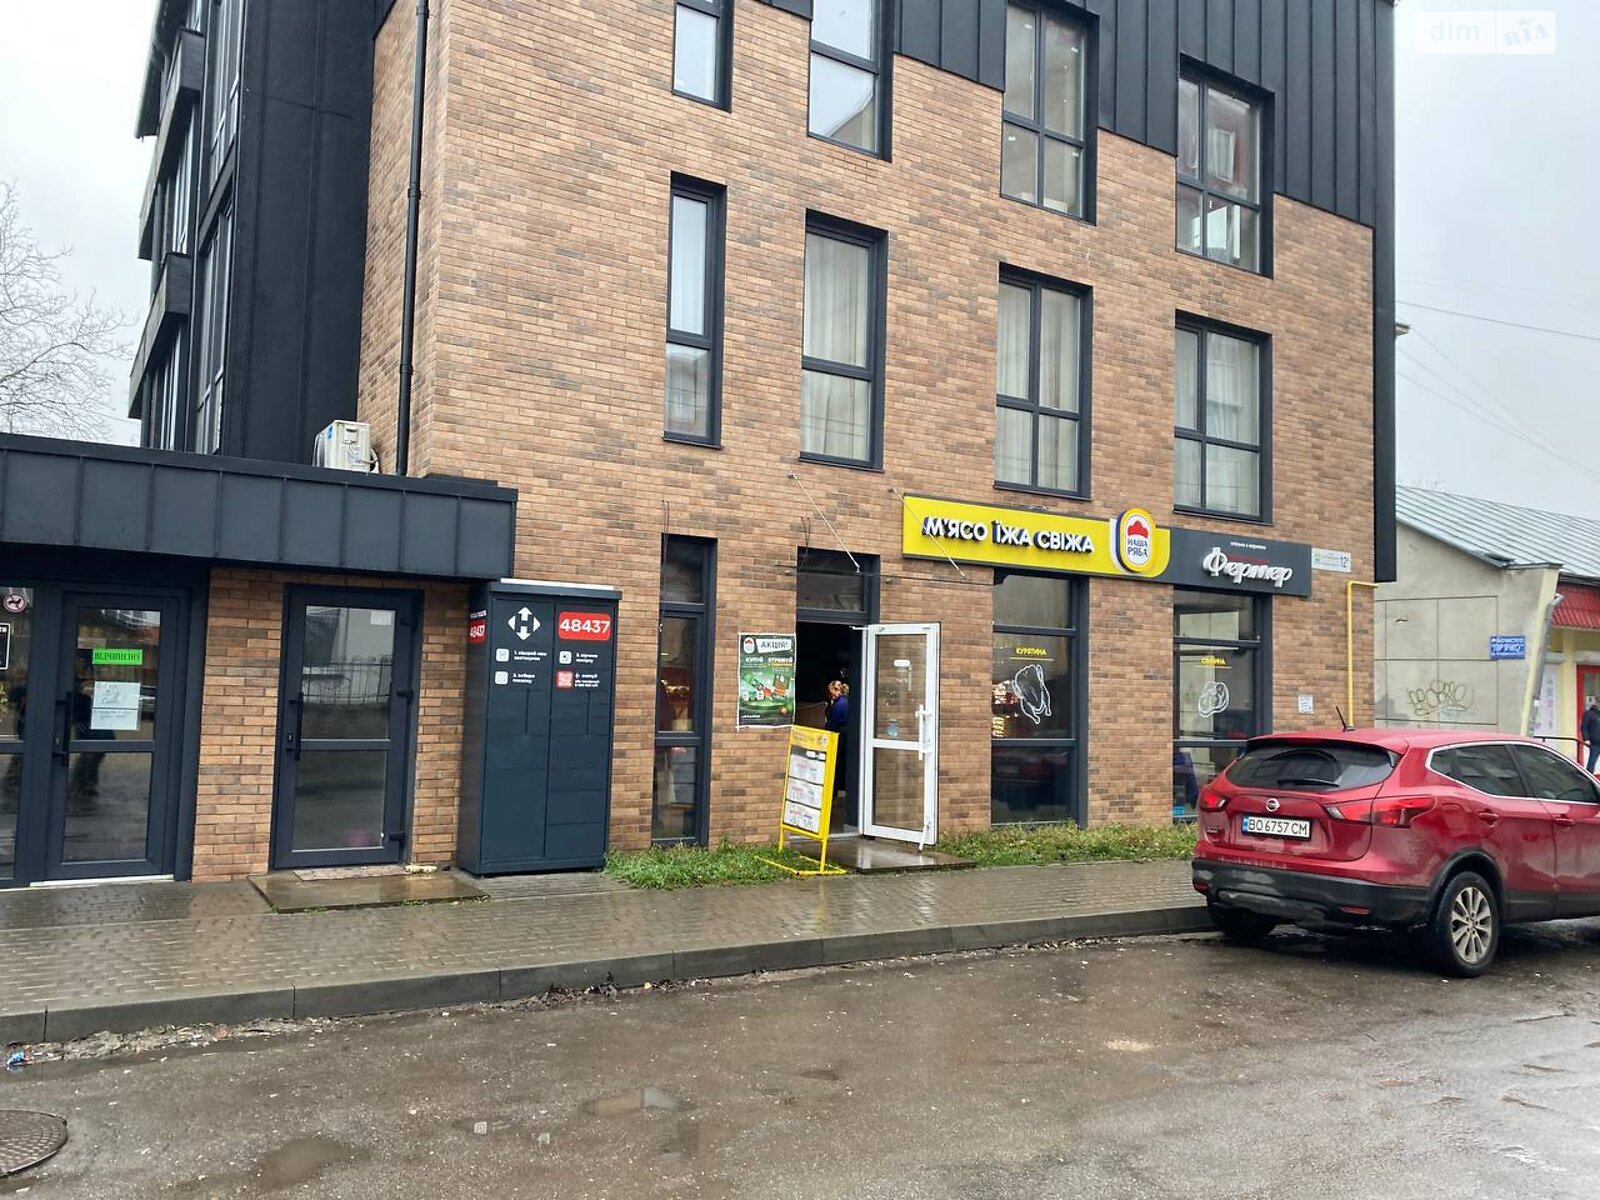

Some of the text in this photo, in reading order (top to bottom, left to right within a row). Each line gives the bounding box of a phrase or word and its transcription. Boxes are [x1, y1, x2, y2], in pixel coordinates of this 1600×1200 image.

[923, 515, 1095, 554] М'ЯСО ЇЖА СВІЖА
[1127, 538, 1149, 548] НАША
[1127, 547, 1149, 558] РЯБА
[1202, 547, 1294, 588] Фермер
[559, 618, 610, 634] 48437
